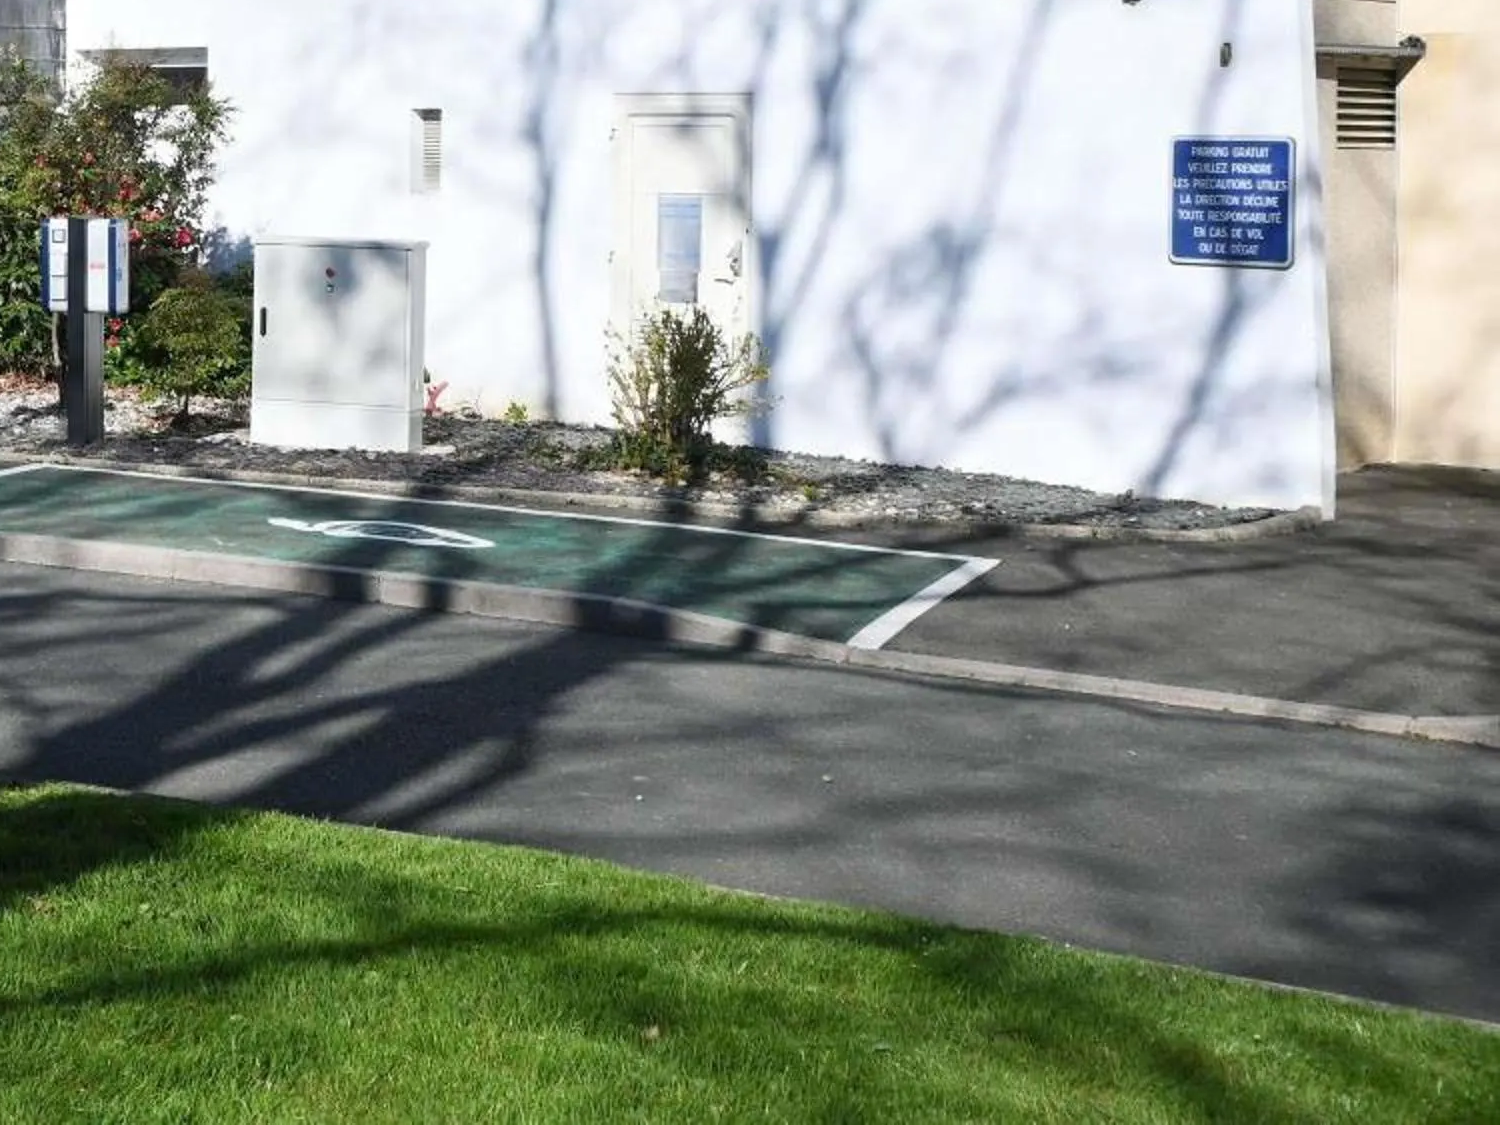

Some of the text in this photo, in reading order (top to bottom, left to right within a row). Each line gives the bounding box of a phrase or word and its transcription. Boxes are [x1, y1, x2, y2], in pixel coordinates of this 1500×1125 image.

[1191, 146, 1269, 158] PARKING GRATUIT
[1188, 162, 1273, 175] VEUILLEZ PRENDRE
[1173, 178, 1190, 188] LES
[1179, 194, 1192, 204] LA
[1195, 194, 1239, 206] DIRECTION
[1178, 209, 1205, 221] TOUTE
[1193, 226, 1265, 240] EN CAS DE VOL
[1198, 242, 1213, 253] OU
